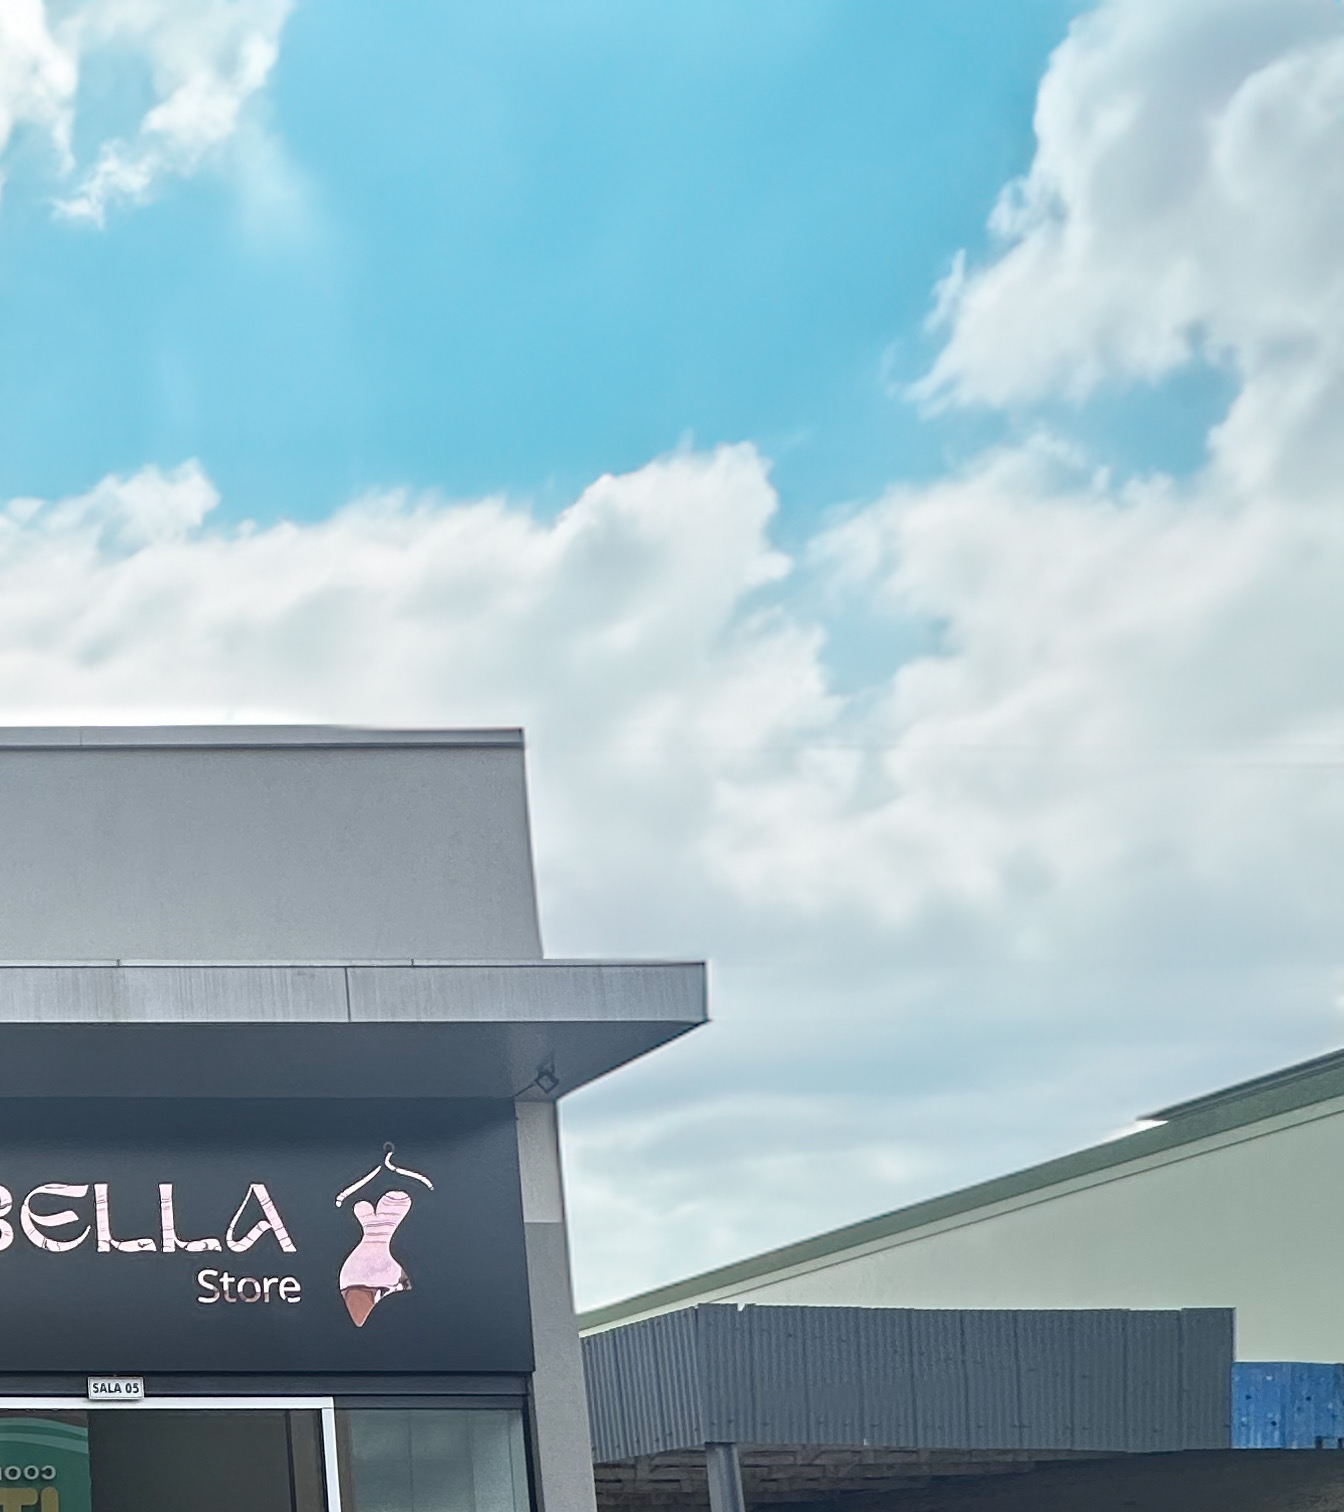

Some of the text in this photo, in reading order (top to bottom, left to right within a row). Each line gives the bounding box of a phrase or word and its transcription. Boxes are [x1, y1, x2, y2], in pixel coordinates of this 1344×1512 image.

[197, 1268, 301, 1304] Store
[92, 1382, 140, 1394] SALA 05
